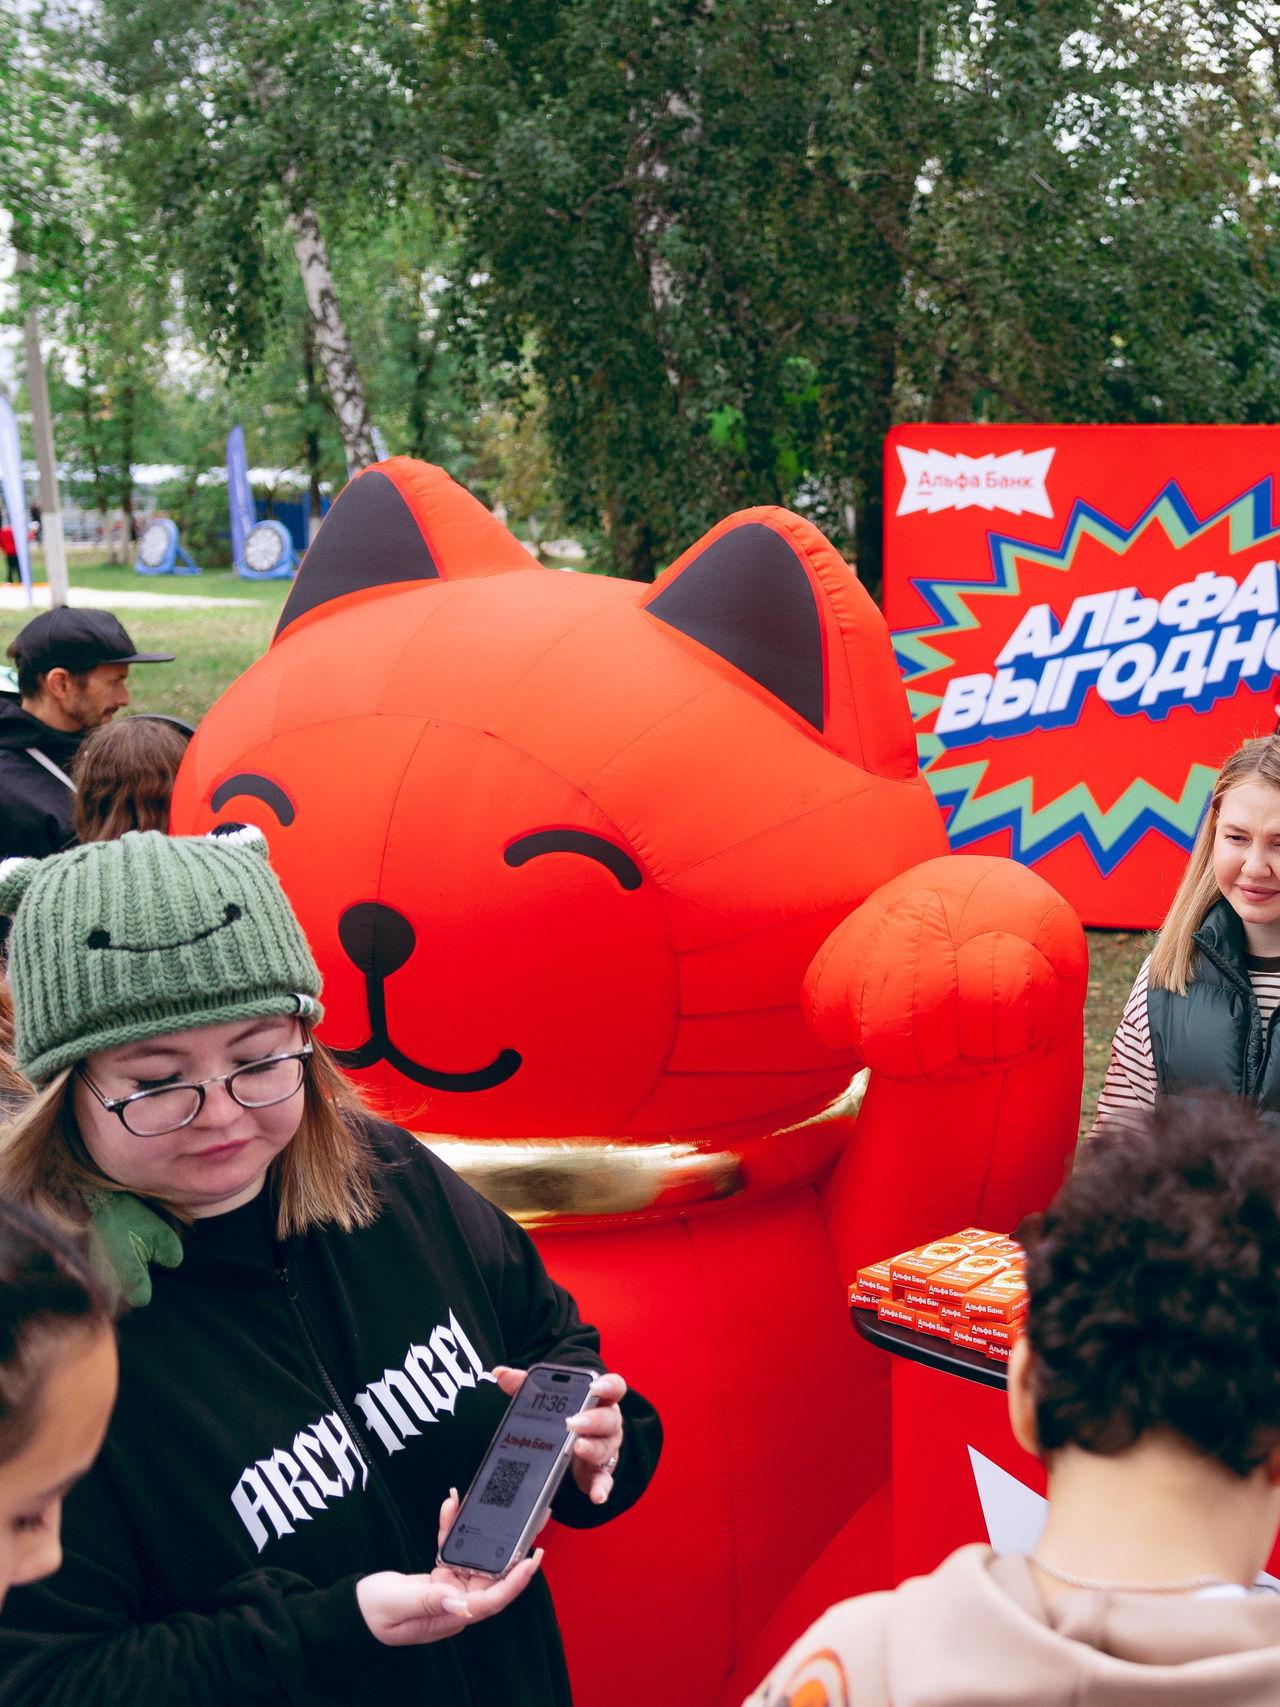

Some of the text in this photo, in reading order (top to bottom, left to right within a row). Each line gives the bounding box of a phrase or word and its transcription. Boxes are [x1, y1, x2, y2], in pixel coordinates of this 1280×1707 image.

[918, 471, 1033, 494] Альфа Банк
[995, 560, 1279, 667] АЛЬФА
[892, 1271, 912, 1282] Альфа
[912, 1275, 926, 1284] Банк
[859, 1278, 890, 1293] Альфа Банк
[929, 1285, 949, 1295] Альфа
[851, 1293, 879, 1304] Альфа Ба
[907, 1294, 939, 1307] Альфа Бан
[881, 1307, 912, 1322] Альфа Банк
[941, 1307, 961, 1317] Альфа
[965, 1302, 1004, 1315] Альфа Банк
[918, 1319, 950, 1334] Альфа Банк
[972, 1324, 992, 1335] Альфа
[992, 1328, 1009, 1339] Банк
[953, 1331, 972, 1341] Альфа
[989, 1345, 1008, 1355] Альфа
[531, 1393, 569, 1414] 11:36
[500, 1433, 555, 1452] Альфа Банк
